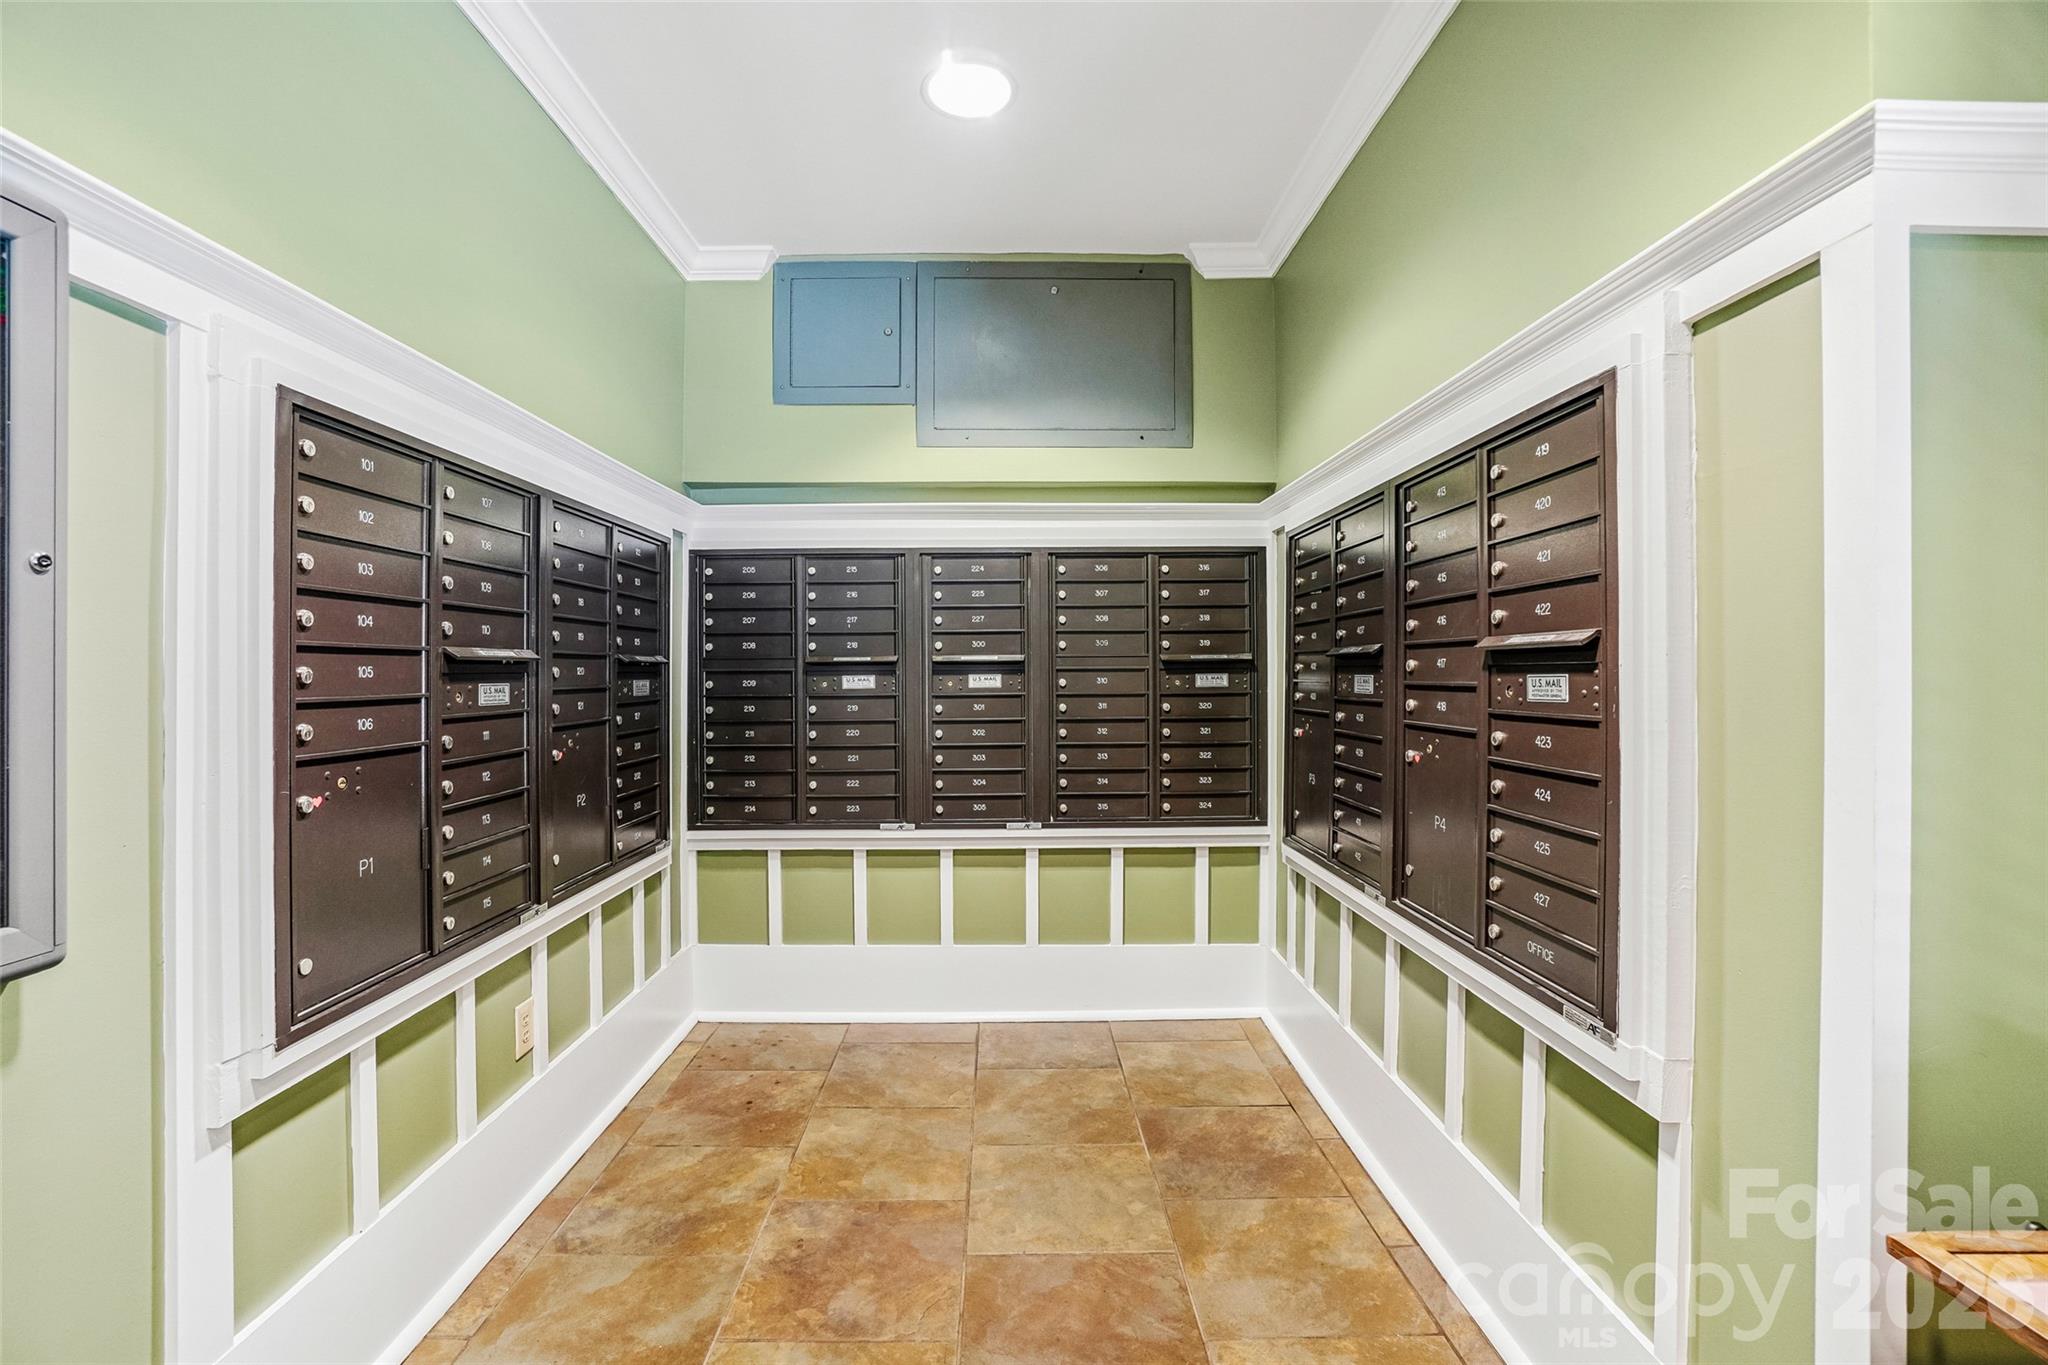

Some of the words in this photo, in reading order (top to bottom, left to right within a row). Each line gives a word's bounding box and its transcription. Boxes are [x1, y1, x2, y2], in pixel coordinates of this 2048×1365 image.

[1535, 442, 1550, 457] 419
[361, 458, 374, 473] 101
[1534, 495, 1552, 511] 420
[358, 509, 374, 525] 102
[1536, 549, 1551, 563] 421
[357, 562, 374, 576] 103
[970, 564, 985, 573] 224
[1094, 564, 1109, 572] 306
[1198, 563, 1210, 571] 316
[971, 590, 985, 598] 225
[1094, 589, 1109, 597] 307
[1198, 588, 1210, 597] 317
[1534, 602, 1552, 616] 422
[357, 614, 374, 628] 104
[742, 616, 756, 624] 207
[846, 615, 858, 624] 217
[971, 615, 985, 623] 227
[971, 640, 986, 648] 300
[1095, 639, 1109, 647] 309
[1199, 639, 1211, 647] 319
[357, 665, 374, 679] 105
[742, 679, 757, 687] 209
[1096, 677, 1108, 685] 310
[1545, 678, 1562, 688] MAIL
[743, 705, 756, 713] 210
[847, 704, 859, 712] 219
[972, 703, 985, 711] 301
[1097, 702, 1108, 710] 311
[1198, 702, 1213, 710] 320
[357, 717, 374, 731] 106
[744, 730, 755, 738] 211
[845, 729, 860, 737] 220
[972, 728, 986, 737] 302
[1096, 727, 1108, 735] 312
[1199, 727, 1212, 735] 321
[1534, 735, 1552, 749] 423
[744, 754, 756, 763] 212
[847, 754, 859, 762] 221
[972, 753, 986, 762] 303
[1096, 752, 1109, 760] 313
[1198, 751, 1212, 759] 322
[846, 779, 860, 787] 222
[972, 778, 987, 786] 304
[1096, 777, 1109, 785] 314
[1198, 776, 1213, 784] 323
[1534, 787, 1551, 803] 424
[576, 793, 587, 808] P2
[744, 805, 756, 813] 214
[1198, 801, 1213, 809] 324
[1434, 815, 1447, 833] P4
[1533, 840, 1551, 856] 425
[359, 856, 374, 878] P1
[1533, 891, 1551, 908] 427
[1526, 940, 1555, 965] OFFICE
